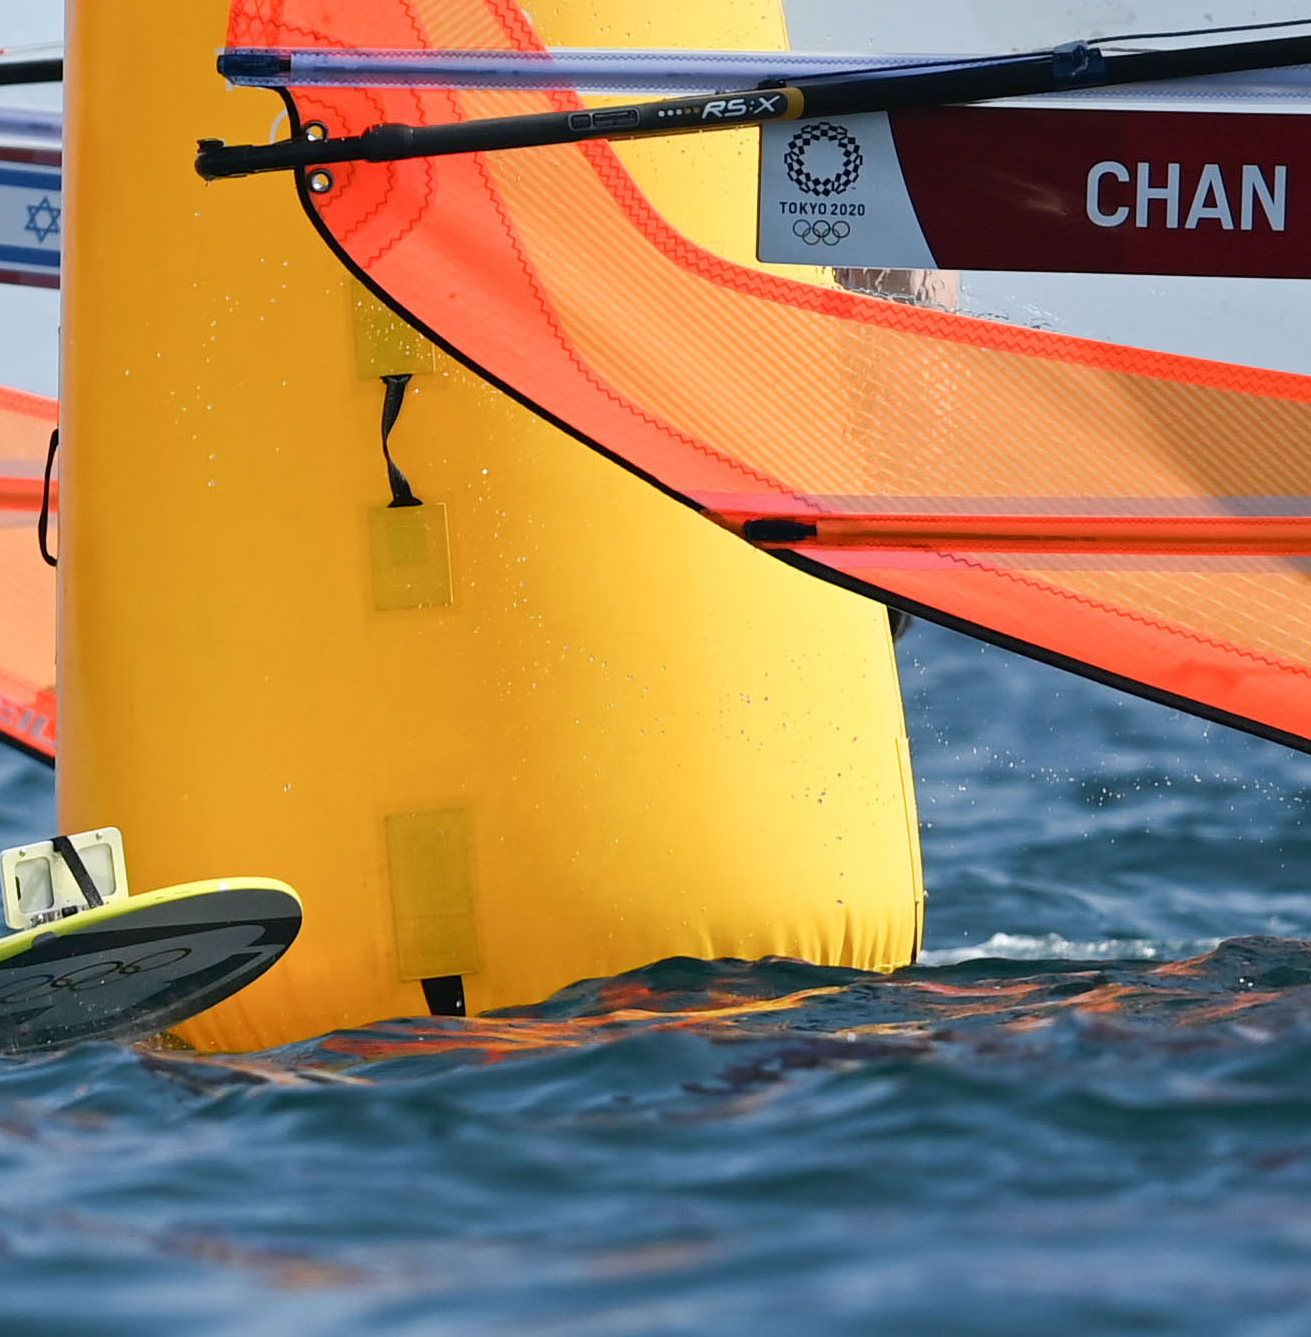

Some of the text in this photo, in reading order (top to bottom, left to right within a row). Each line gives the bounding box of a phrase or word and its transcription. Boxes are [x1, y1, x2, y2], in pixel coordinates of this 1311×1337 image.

[702, 95, 780, 119] RS:X
[1086, 160, 1288, 232] CHAN
[779, 201, 866, 216] TOKYO 2020
